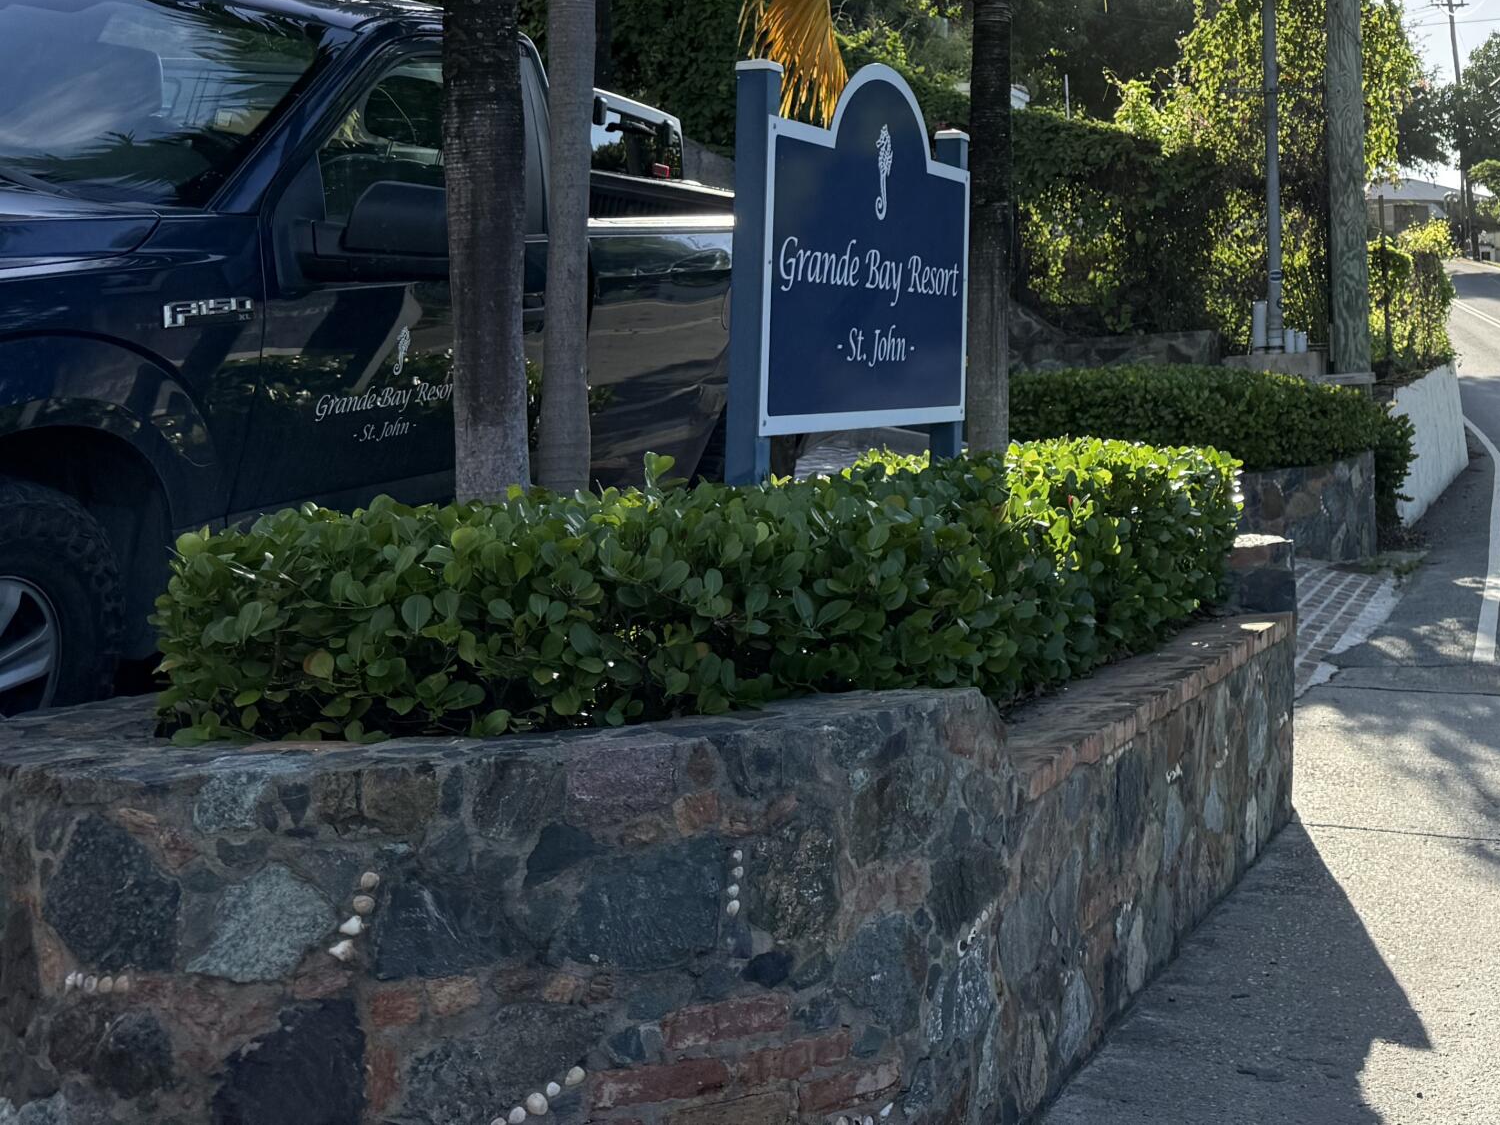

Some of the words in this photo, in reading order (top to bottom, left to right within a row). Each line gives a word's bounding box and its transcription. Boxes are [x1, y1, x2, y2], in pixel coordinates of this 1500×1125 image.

[779, 236, 860, 292] Grande
[865, 249, 903, 307] Bay
[907, 255, 959, 297] Resort
[846, 327, 867, 362] St.
[868, 324, 906, 367] John
[315, 385, 376, 421] Grande
[379, 386, 413, 412] Bay
[359, 424, 376, 442] St.
[376, 417, 410, 442] John
